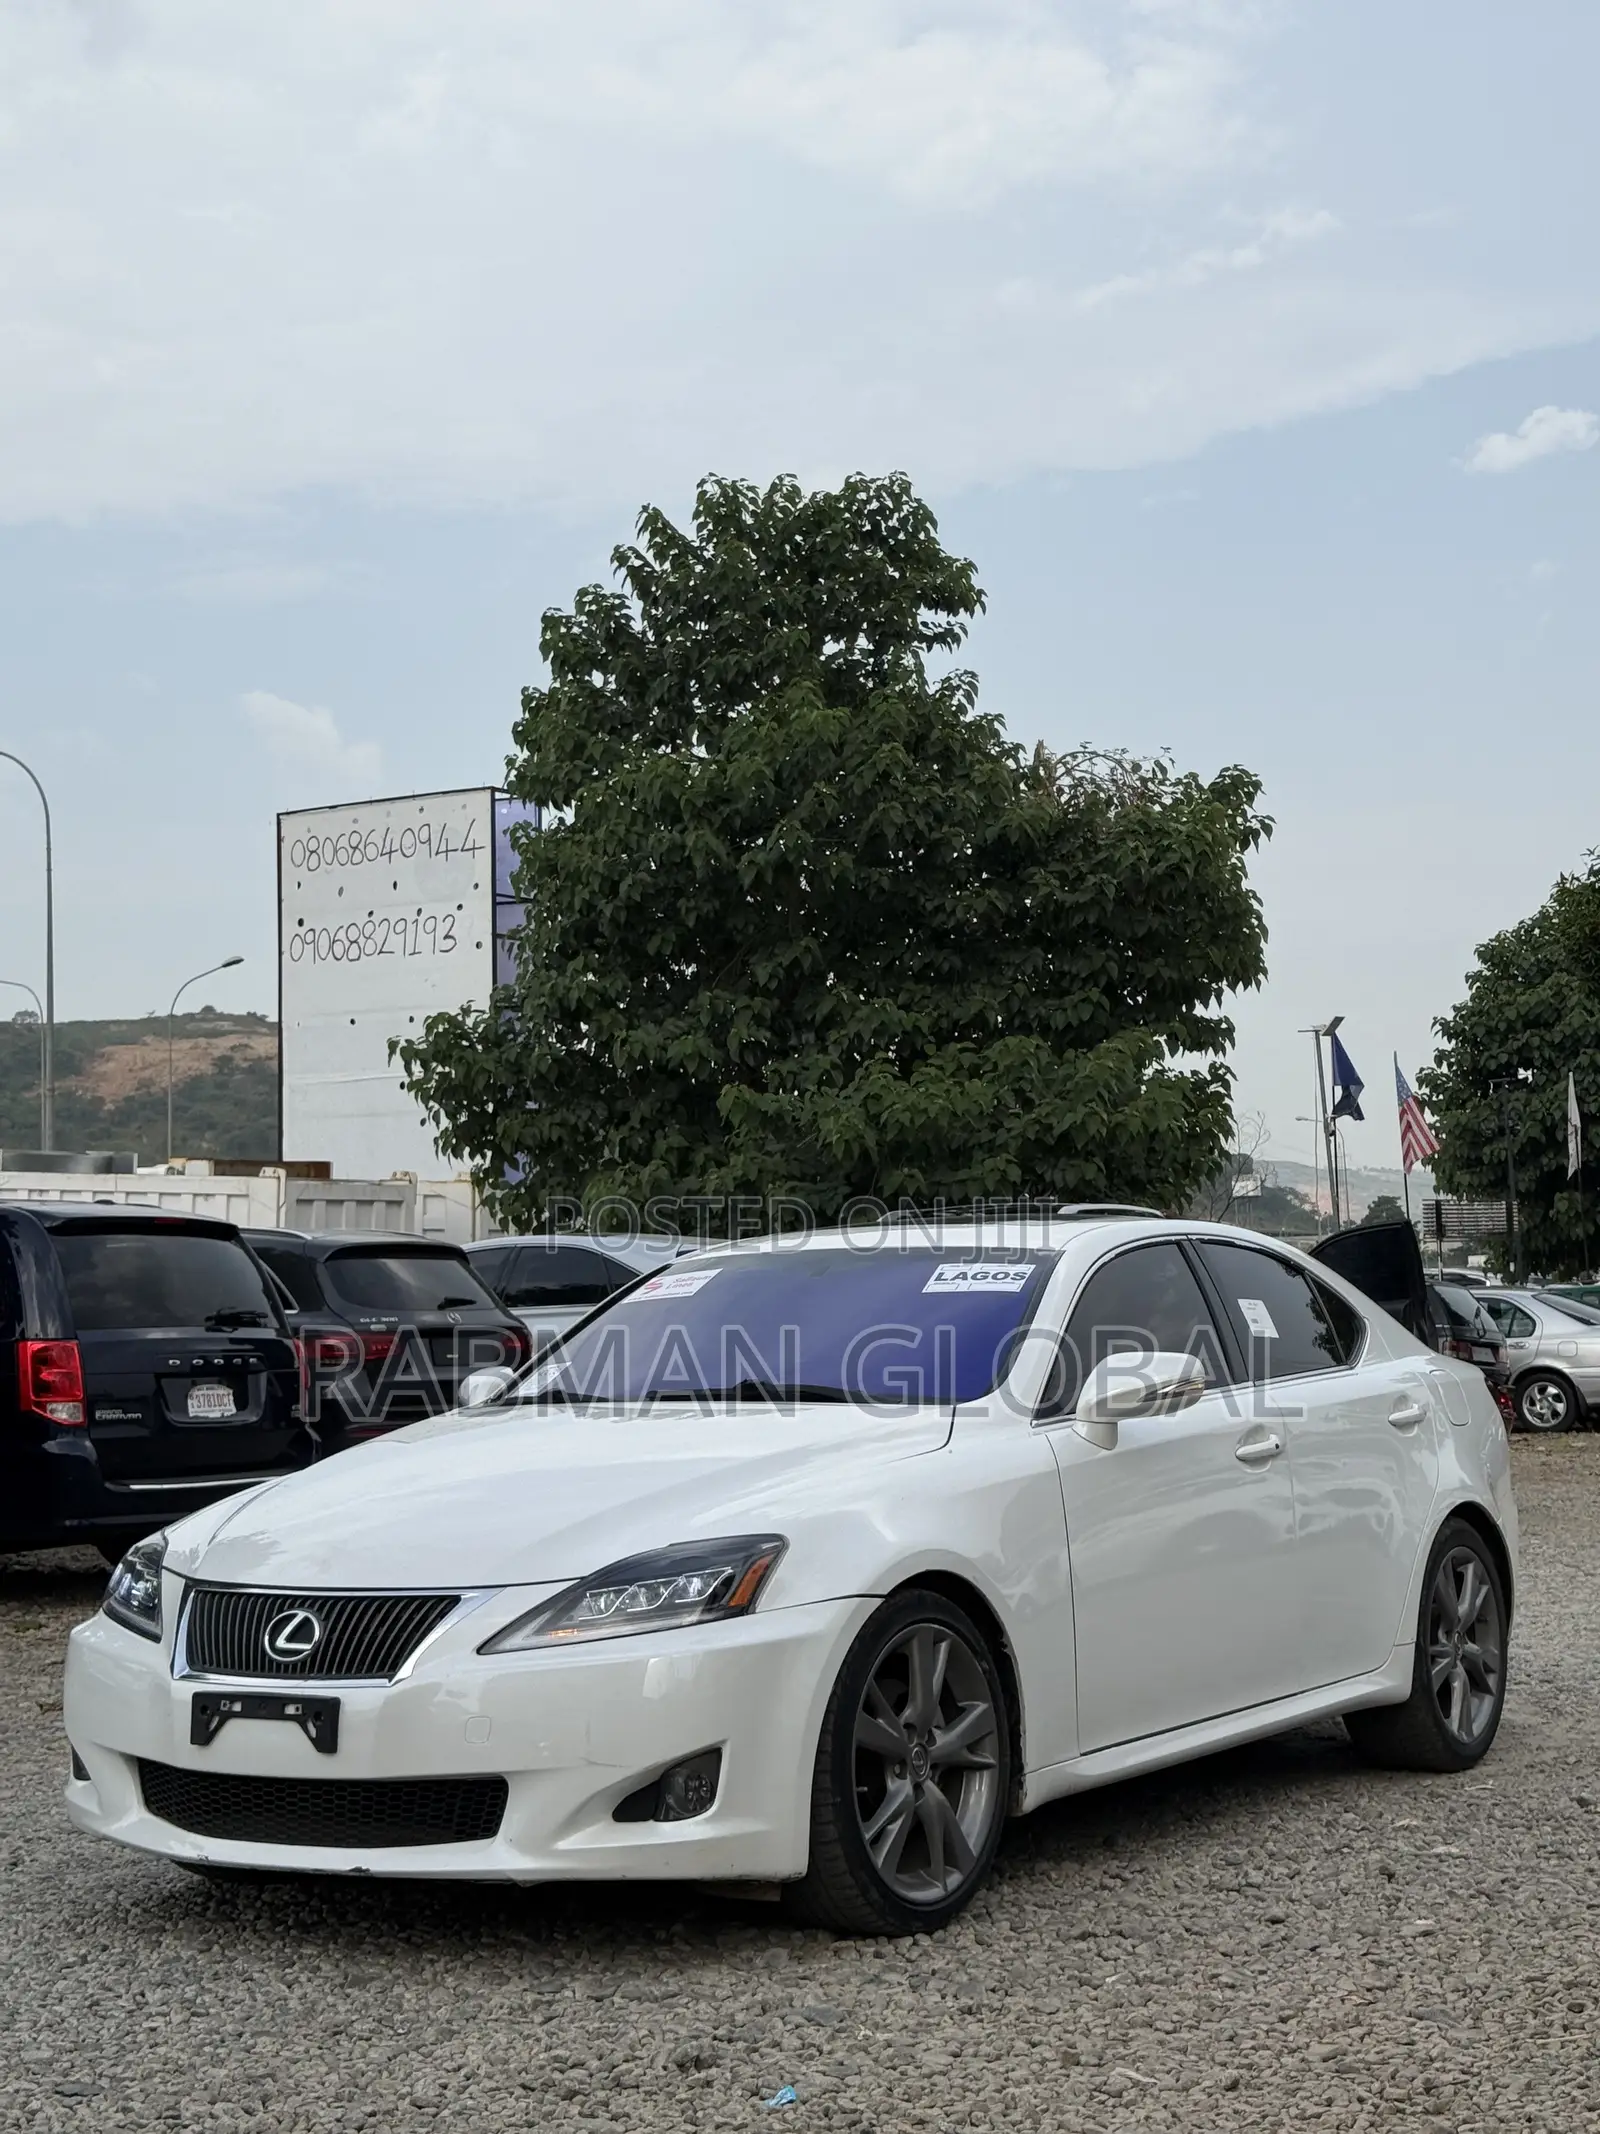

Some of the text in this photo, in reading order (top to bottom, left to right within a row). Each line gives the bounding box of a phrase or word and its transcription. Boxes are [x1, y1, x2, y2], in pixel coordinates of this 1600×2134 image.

[290, 818, 486, 872] 08068640944
[289, 913, 458, 964] 09068829193
[933, 1271, 1028, 1282] LAGOS
[168, 1358, 258, 1366] DODGE
